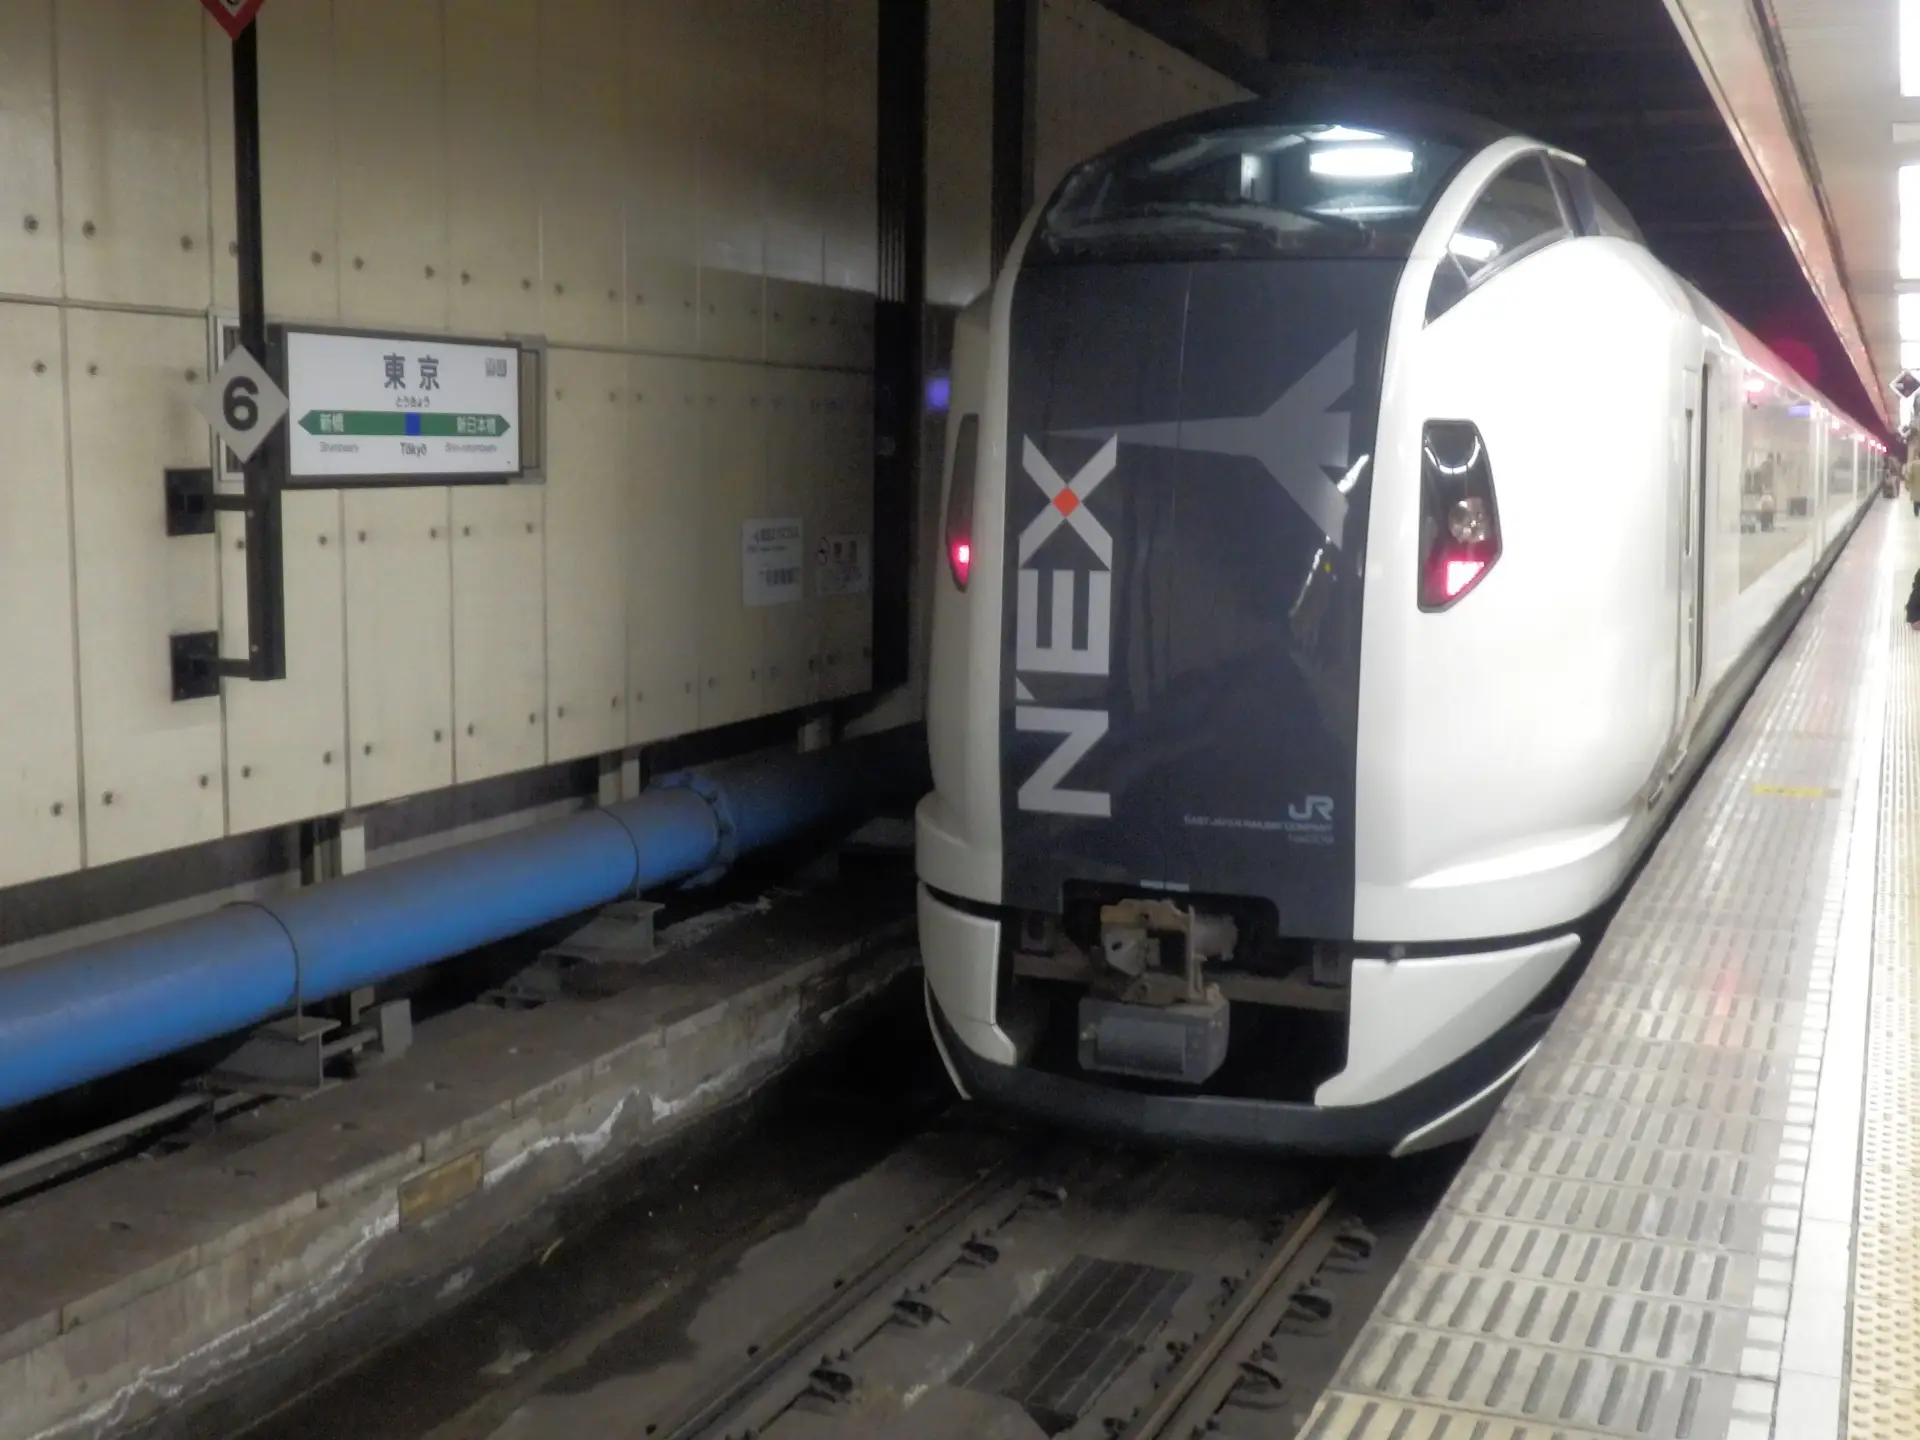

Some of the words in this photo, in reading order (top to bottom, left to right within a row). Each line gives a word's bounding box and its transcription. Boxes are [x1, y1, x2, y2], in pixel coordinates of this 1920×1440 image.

[383, 352, 440, 391] 東京
[222, 376, 259, 432] 6
[1287, 795, 1335, 821] JR
